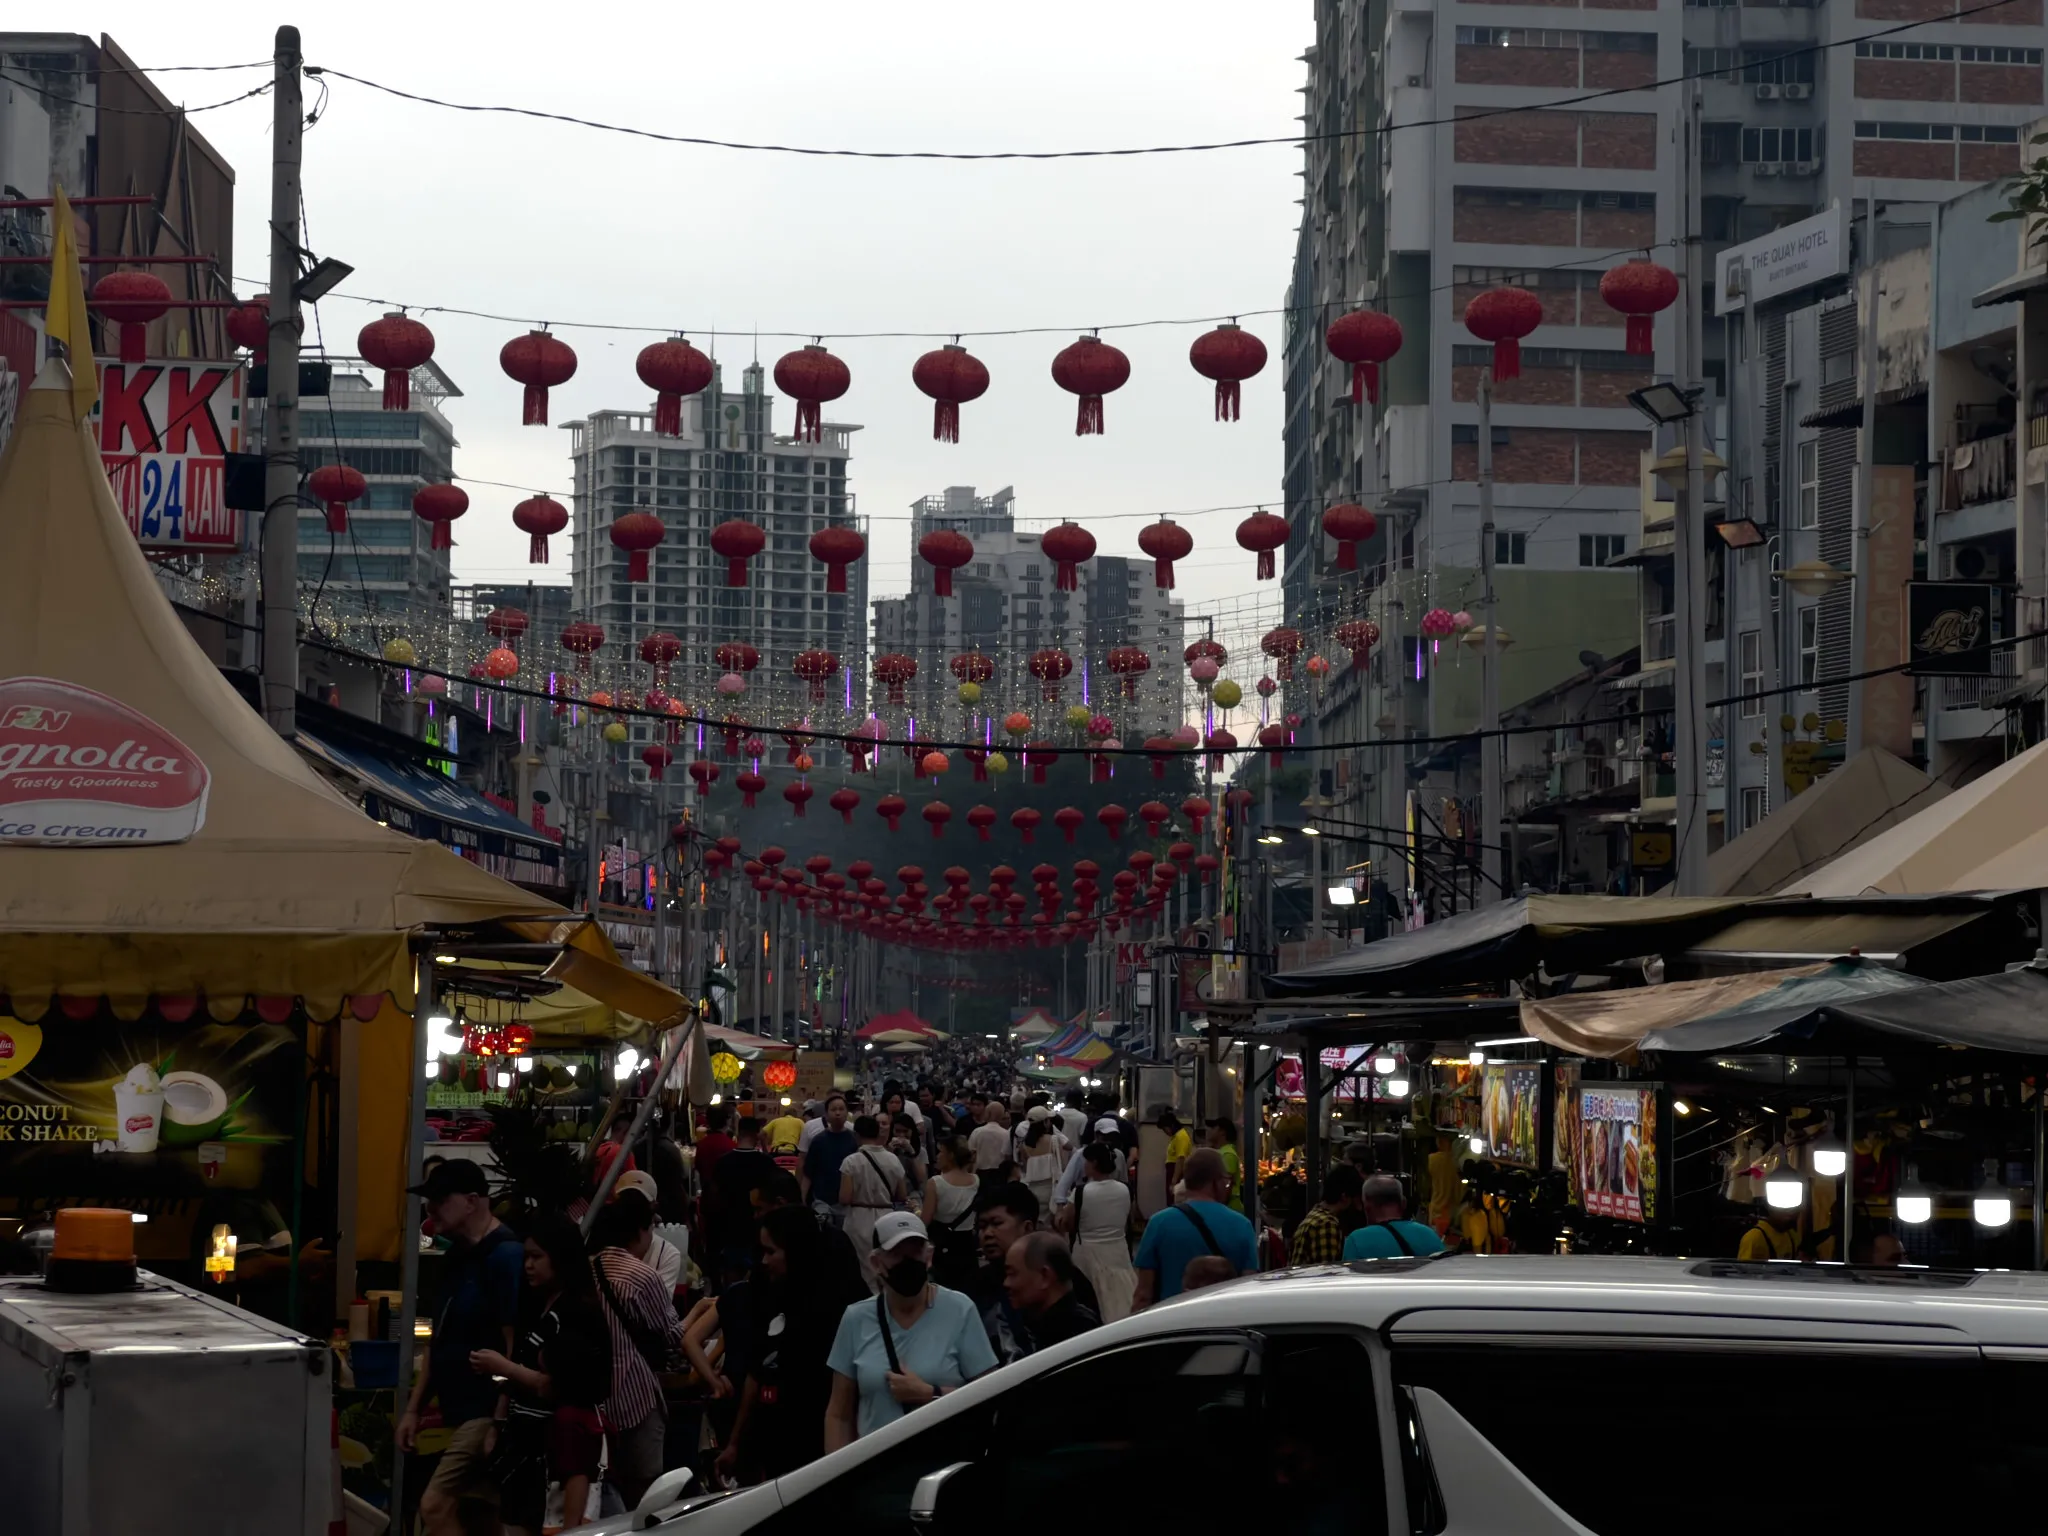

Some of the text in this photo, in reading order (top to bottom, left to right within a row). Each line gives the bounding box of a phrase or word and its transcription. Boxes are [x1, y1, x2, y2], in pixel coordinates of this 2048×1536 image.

[1752, 230, 1828, 270] THE QUAY HOTEL
[101, 364, 230, 455] KK
[142, 459, 182, 539] 24
[187, 466, 231, 535] JAM
[1872, 477, 1902, 595] HOTEL
[12, 776, 159, 790] Tasty Goodness
[0, 819, 148, 839] ce cream
[1118, 943, 1149, 964] KK
[21, 1125, 97, 1141] SHAKE
